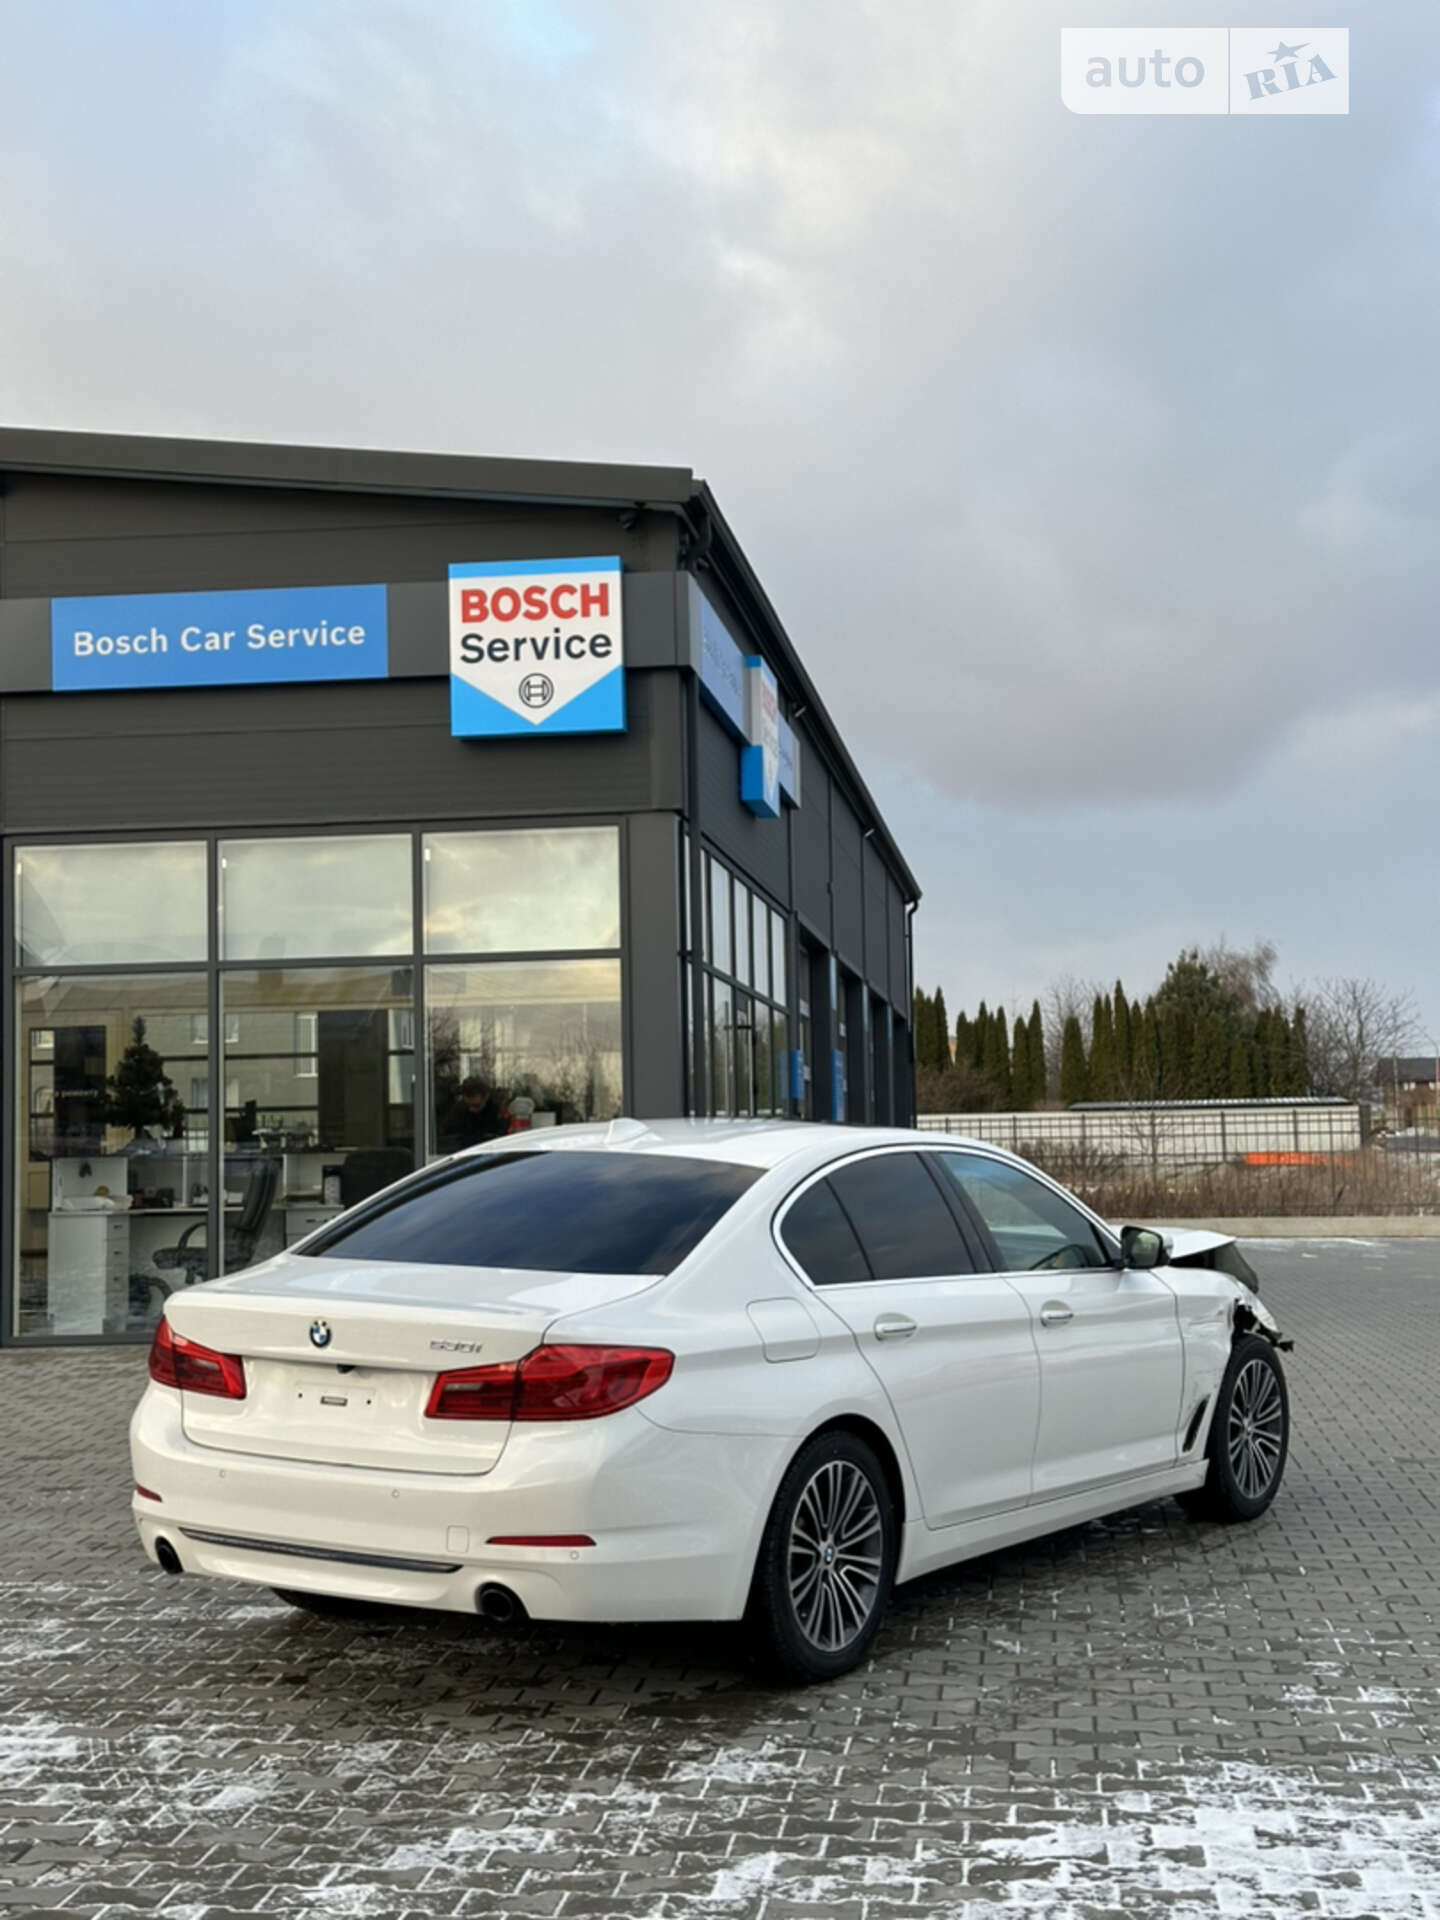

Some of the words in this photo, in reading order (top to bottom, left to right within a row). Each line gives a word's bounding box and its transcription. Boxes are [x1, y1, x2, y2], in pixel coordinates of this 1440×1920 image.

[461, 582, 609, 625] BOSCH
[73, 628, 168, 656] Bosch
[180, 626, 236, 652] Car
[247, 621, 365, 649] Service
[460, 627, 612, 664] Service
